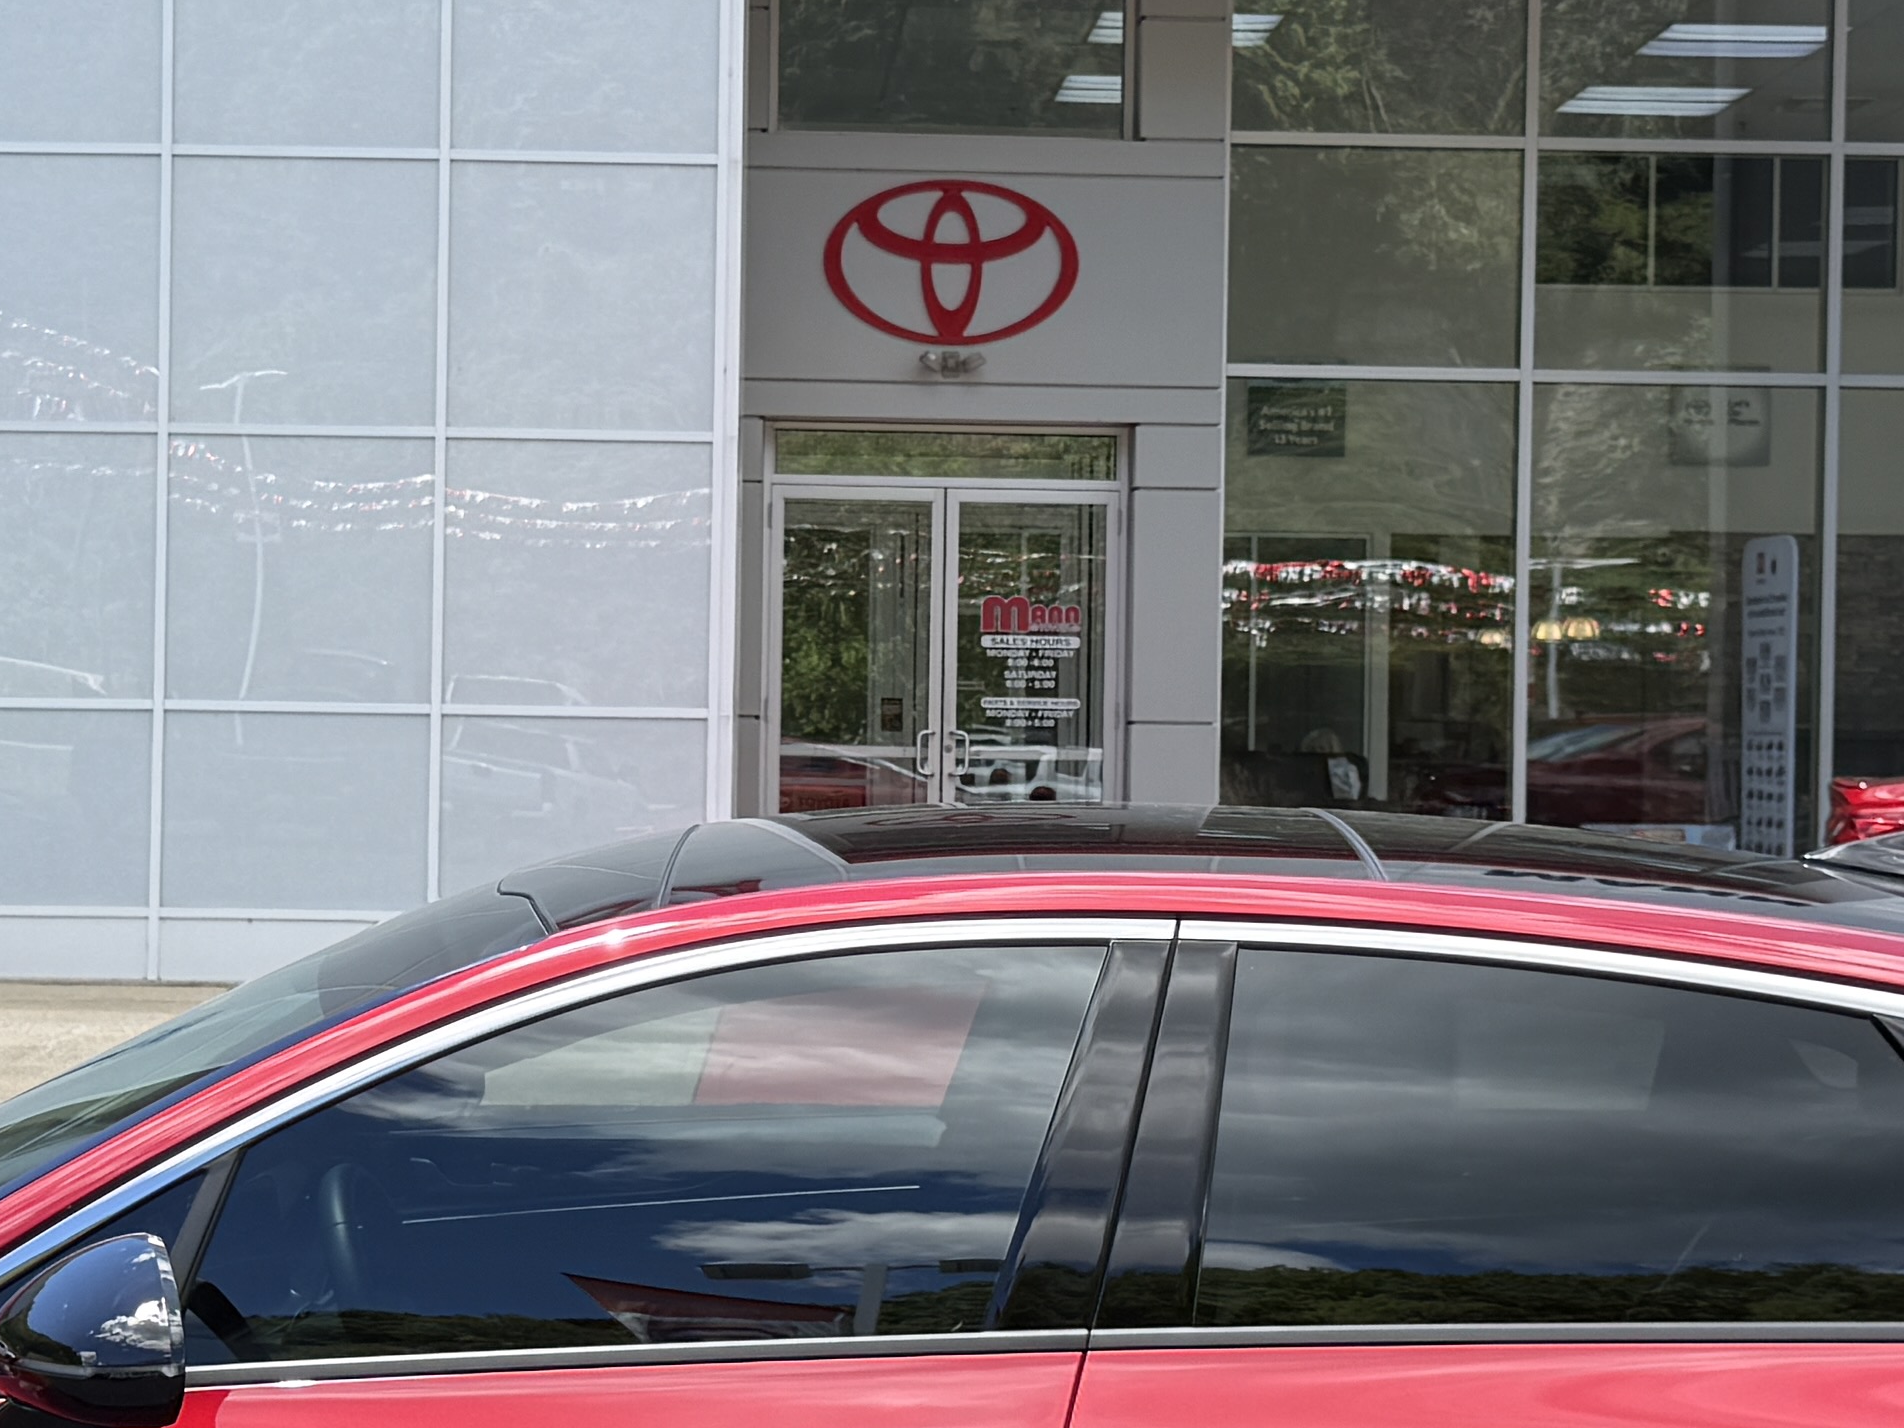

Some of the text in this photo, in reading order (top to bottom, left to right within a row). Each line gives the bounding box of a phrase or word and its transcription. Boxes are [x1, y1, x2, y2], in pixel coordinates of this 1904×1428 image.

[991, 637, 1072, 648] SALES HOURS
[986, 649, 1030, 657] MONDAY
[1038, 650, 1074, 658] FRIDAY
[1004, 670, 1056, 679] SATURDAY
[985, 710, 1030, 718] MONDAY
[1038, 710, 1074, 718] FRIDAY
